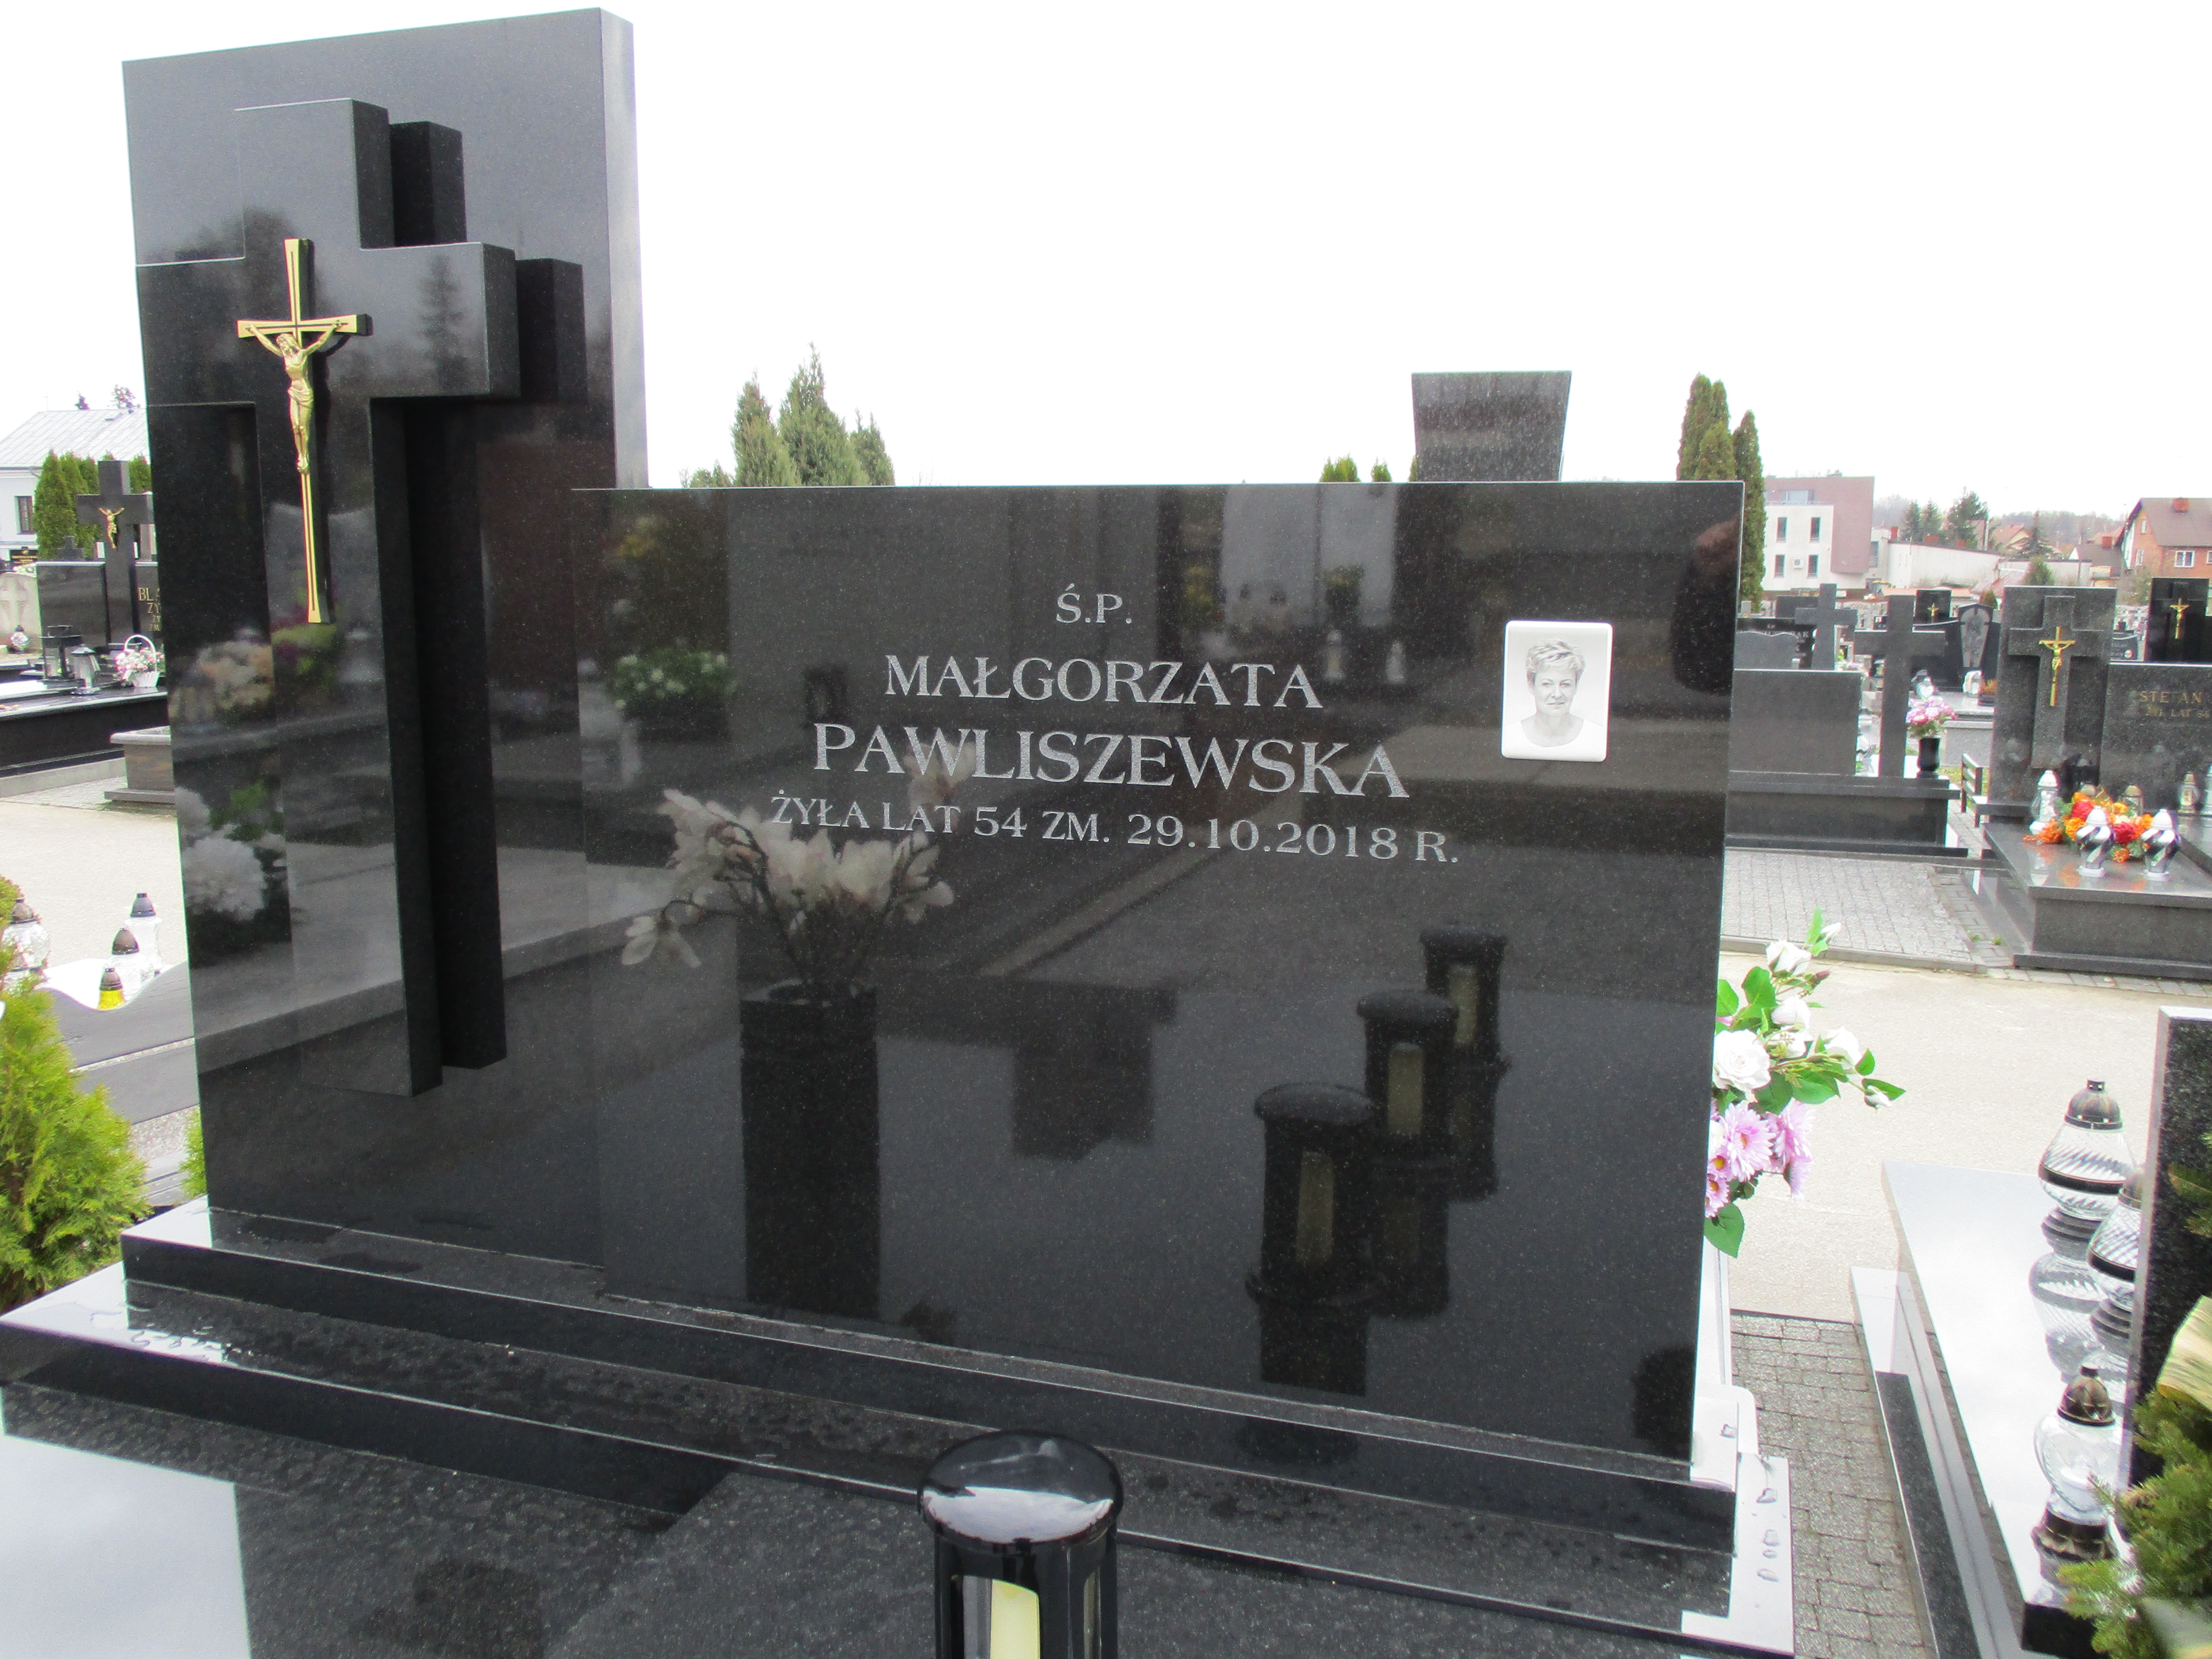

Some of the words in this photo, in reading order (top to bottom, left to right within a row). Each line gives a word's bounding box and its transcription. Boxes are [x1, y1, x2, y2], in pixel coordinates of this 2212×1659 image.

[1055, 583, 1133, 625] Ś.P.
[884, 654, 1324, 708] MAŁGORZATA
[812, 721, 1410, 798] PAWLISZEWSKA
[771, 789, 870, 829] ŻYŁA
[882, 802, 961, 833] LAT
[974, 806, 1028, 838] 54
[1042, 811, 1110, 843] ZM.
[1127, 814, 1399, 860] 29.10.2018
[1415, 830, 1458, 863] R.
